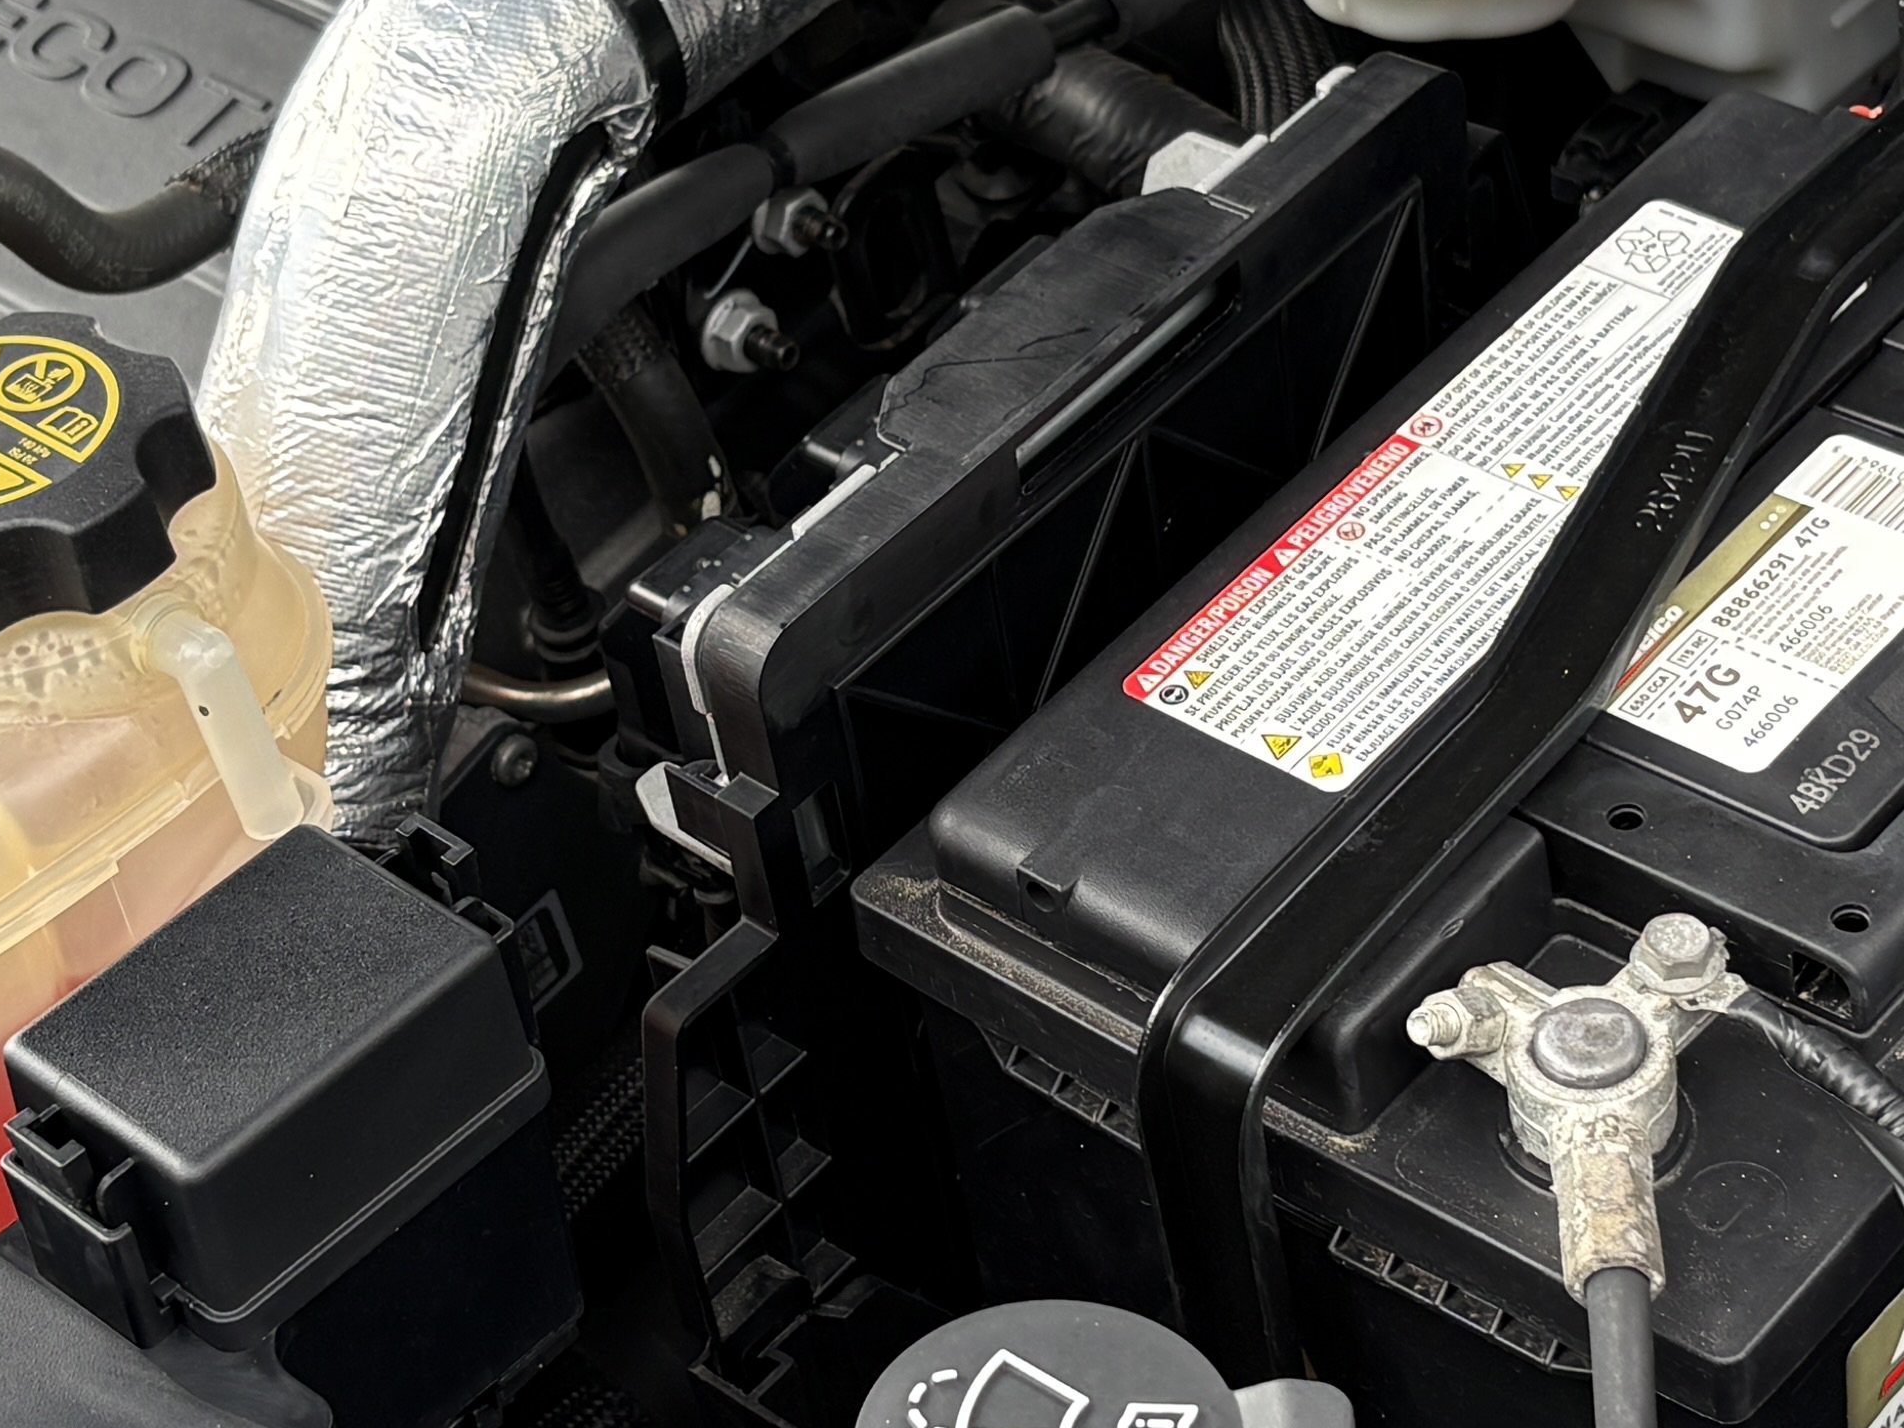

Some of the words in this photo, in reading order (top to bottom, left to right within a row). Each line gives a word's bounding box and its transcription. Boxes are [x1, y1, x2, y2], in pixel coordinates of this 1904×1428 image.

[1283, 438, 1414, 552] PELIGRO/VENENO
[1378, 544, 1394, 556] DE
[1427, 499, 1443, 511] DE
[1362, 531, 1386, 550] PAS
[1710, 546, 1795, 631] 88866291
[1794, 516, 1830, 548] 47G
[1145, 562, 1277, 678] DANGER/POISON
[1183, 703, 1201, 717] SE
[1237, 648, 1259, 666] LES
[1277, 611, 1299, 629] LES
[1294, 595, 1317, 614] GAZ
[1194, 634, 1229, 663] SHIELD
[1247, 573, 1296, 615] EXPLOSIVE
[1213, 694, 1258, 731] PROTEJA
[1251, 677, 1274, 696] LOS
[1293, 639, 1316, 657] LOS
[1310, 613, 1344, 640] GASES
[1337, 567, 1393, 615] EXPLOSIVOS
[1325, 720, 1357, 748] FLUSH
[1353, 698, 1380, 720] EYES
[1375, 646, 1433, 700] IMMEDIATELY
[1430, 624, 1457, 647] WITH
[1482, 580, 1503, 597] GET
[1498, 548, 1539, 582] MEDICAL
[1676, 648, 1695, 663] 115
[1690, 634, 1708, 649] RC
[1778, 598, 1833, 657] 466006
[1273, 685, 1318, 724] SULFURIC
[1312, 666, 1338, 687] ACID
[1333, 651, 1354, 668] CAN
[1288, 699, 1327, 731] L'ACIDE
[1320, 653, 1375, 701] SULFURIQUE
[1369, 635, 1392, 656] PEUT
[1415, 600, 1431, 611] LA
[1628, 693, 1650, 711] 650
[1646, 674, 1670, 693] CCA
[1673, 663, 1741, 724] 47G
[1340, 742, 1357, 755] SE
[1352, 712, 1387, 743] RINSER
[1382, 697, 1403, 714] LES
[1398, 676, 1425, 698] YEUX
[1354, 723, 1399, 762] ENJUAGE
[1393, 706, 1415, 724] LOS
[1410, 684, 1438, 708] OJOS
[1714, 684, 1762, 730] G074P
[1742, 694, 1799, 747] 466006
[1789, 728, 1881, 815] 4BKD29
